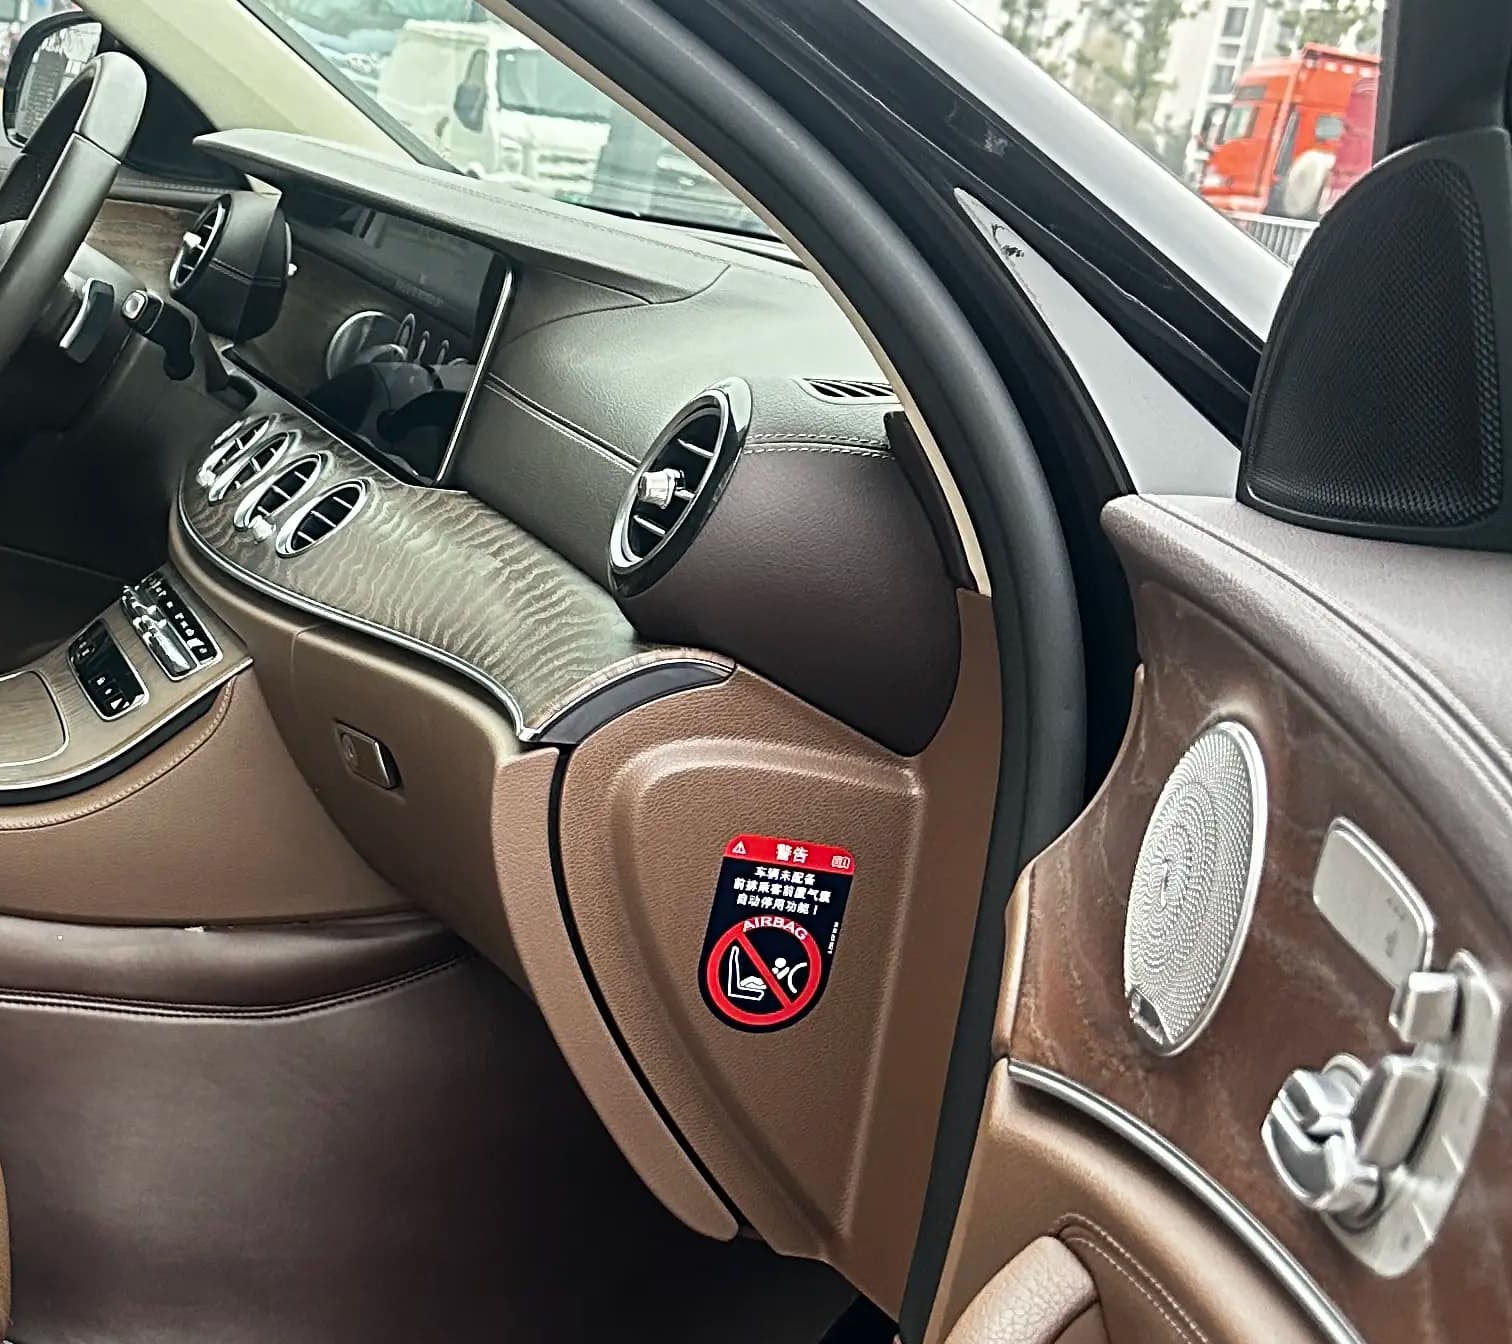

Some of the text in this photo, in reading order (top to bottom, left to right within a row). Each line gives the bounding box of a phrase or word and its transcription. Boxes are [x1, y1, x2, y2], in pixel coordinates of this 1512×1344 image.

[776, 843, 808, 863] 警告
[754, 866, 816, 885] 车辆未配备
[742, 915, 808, 941] AIRBAG
